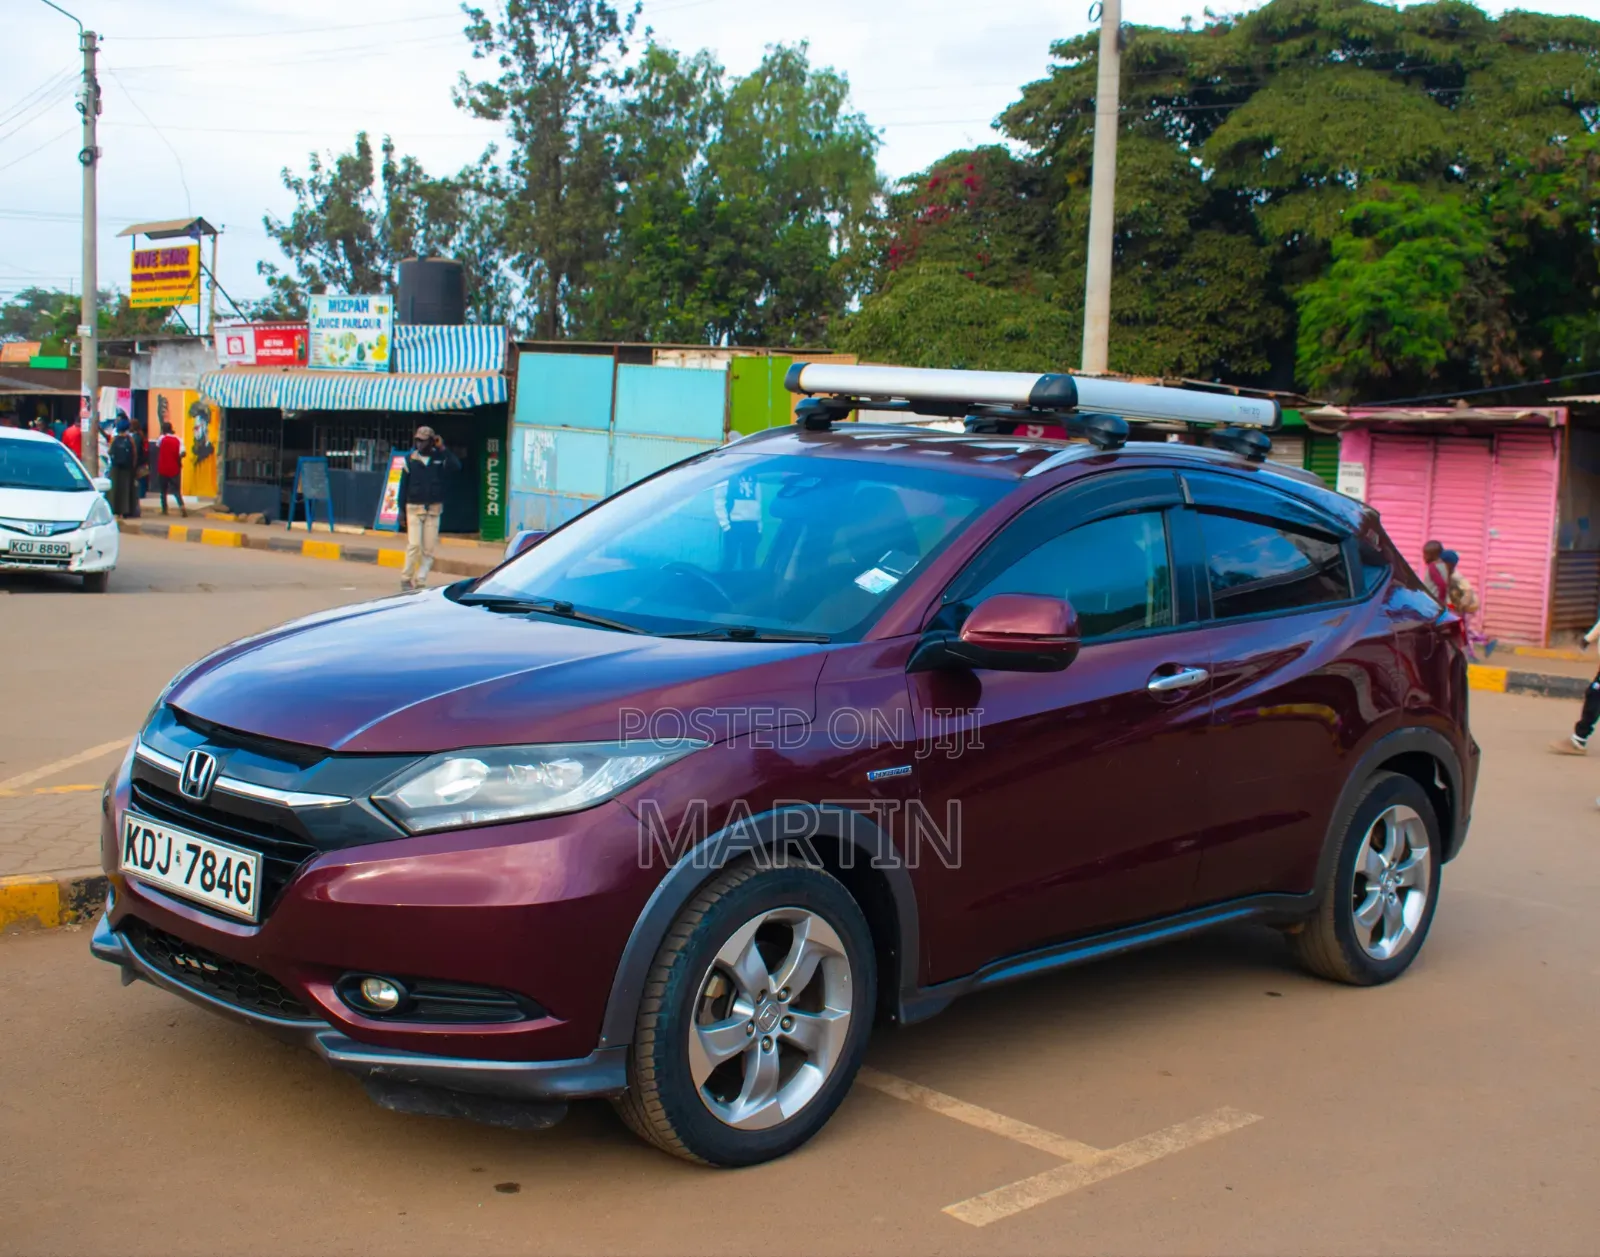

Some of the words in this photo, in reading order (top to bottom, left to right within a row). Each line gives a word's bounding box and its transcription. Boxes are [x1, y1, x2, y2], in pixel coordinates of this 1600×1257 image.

[133, 249, 158, 269] FIVE
[160, 247, 190, 267] STAR
[328, 299, 369, 313] MIZPAH
[316, 317, 340, 329] JUICE
[342, 317, 382, 330] PARLOUR
[11, 542, 34, 553] KCU
[124, 823, 172, 876] KDJ
[183, 842, 252, 905] 784G
